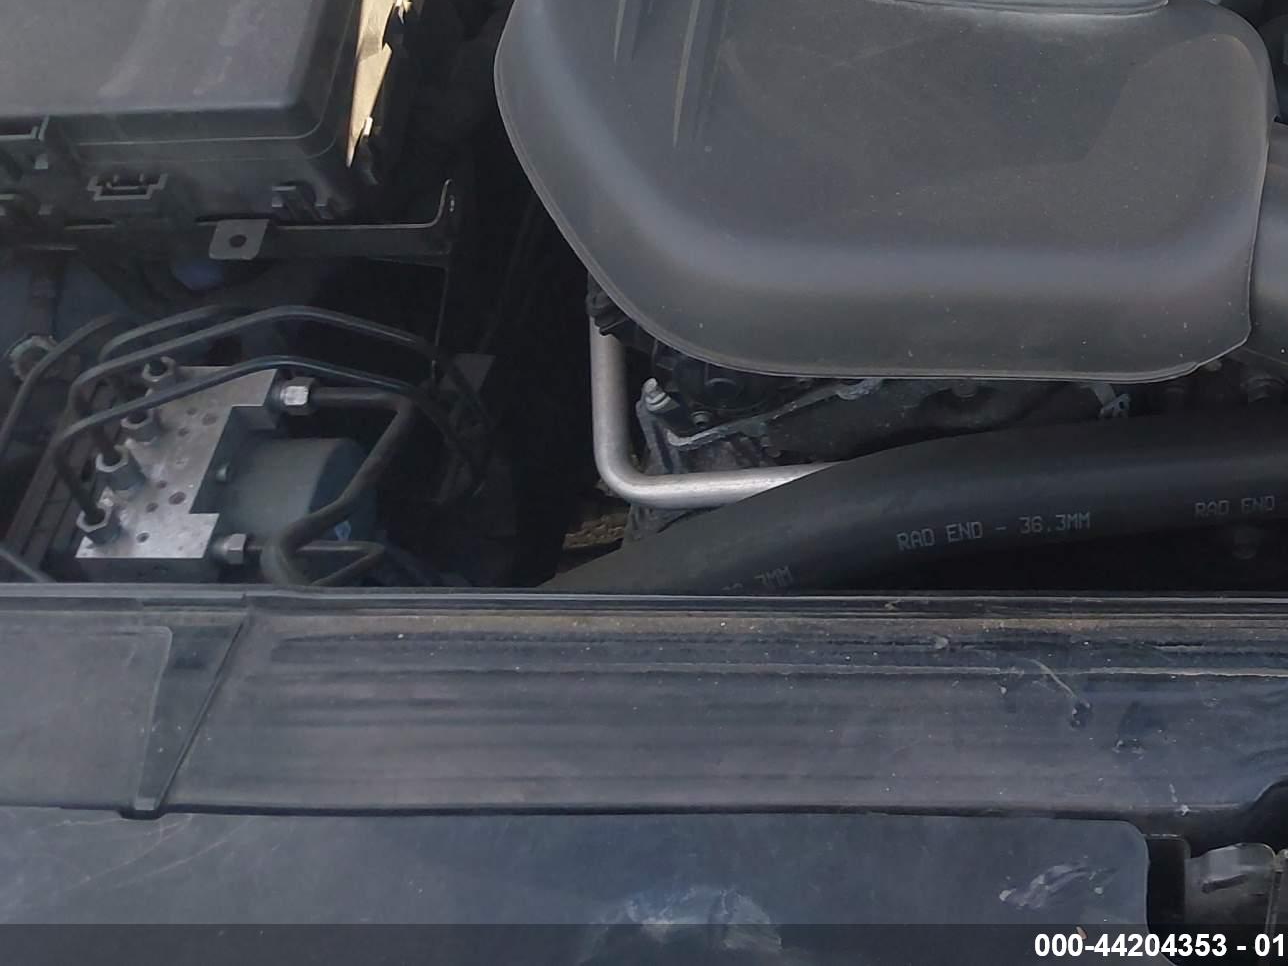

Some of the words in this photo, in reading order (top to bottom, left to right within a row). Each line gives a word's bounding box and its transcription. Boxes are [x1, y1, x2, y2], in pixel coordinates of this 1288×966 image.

[1195, 499, 1230, 515] RAD
[1241, 495, 1275, 513] END
[896, 527, 936, 551] RAD
[946, 521, 984, 543] END
[1018, 512, 1091, 535] 36.3MM
